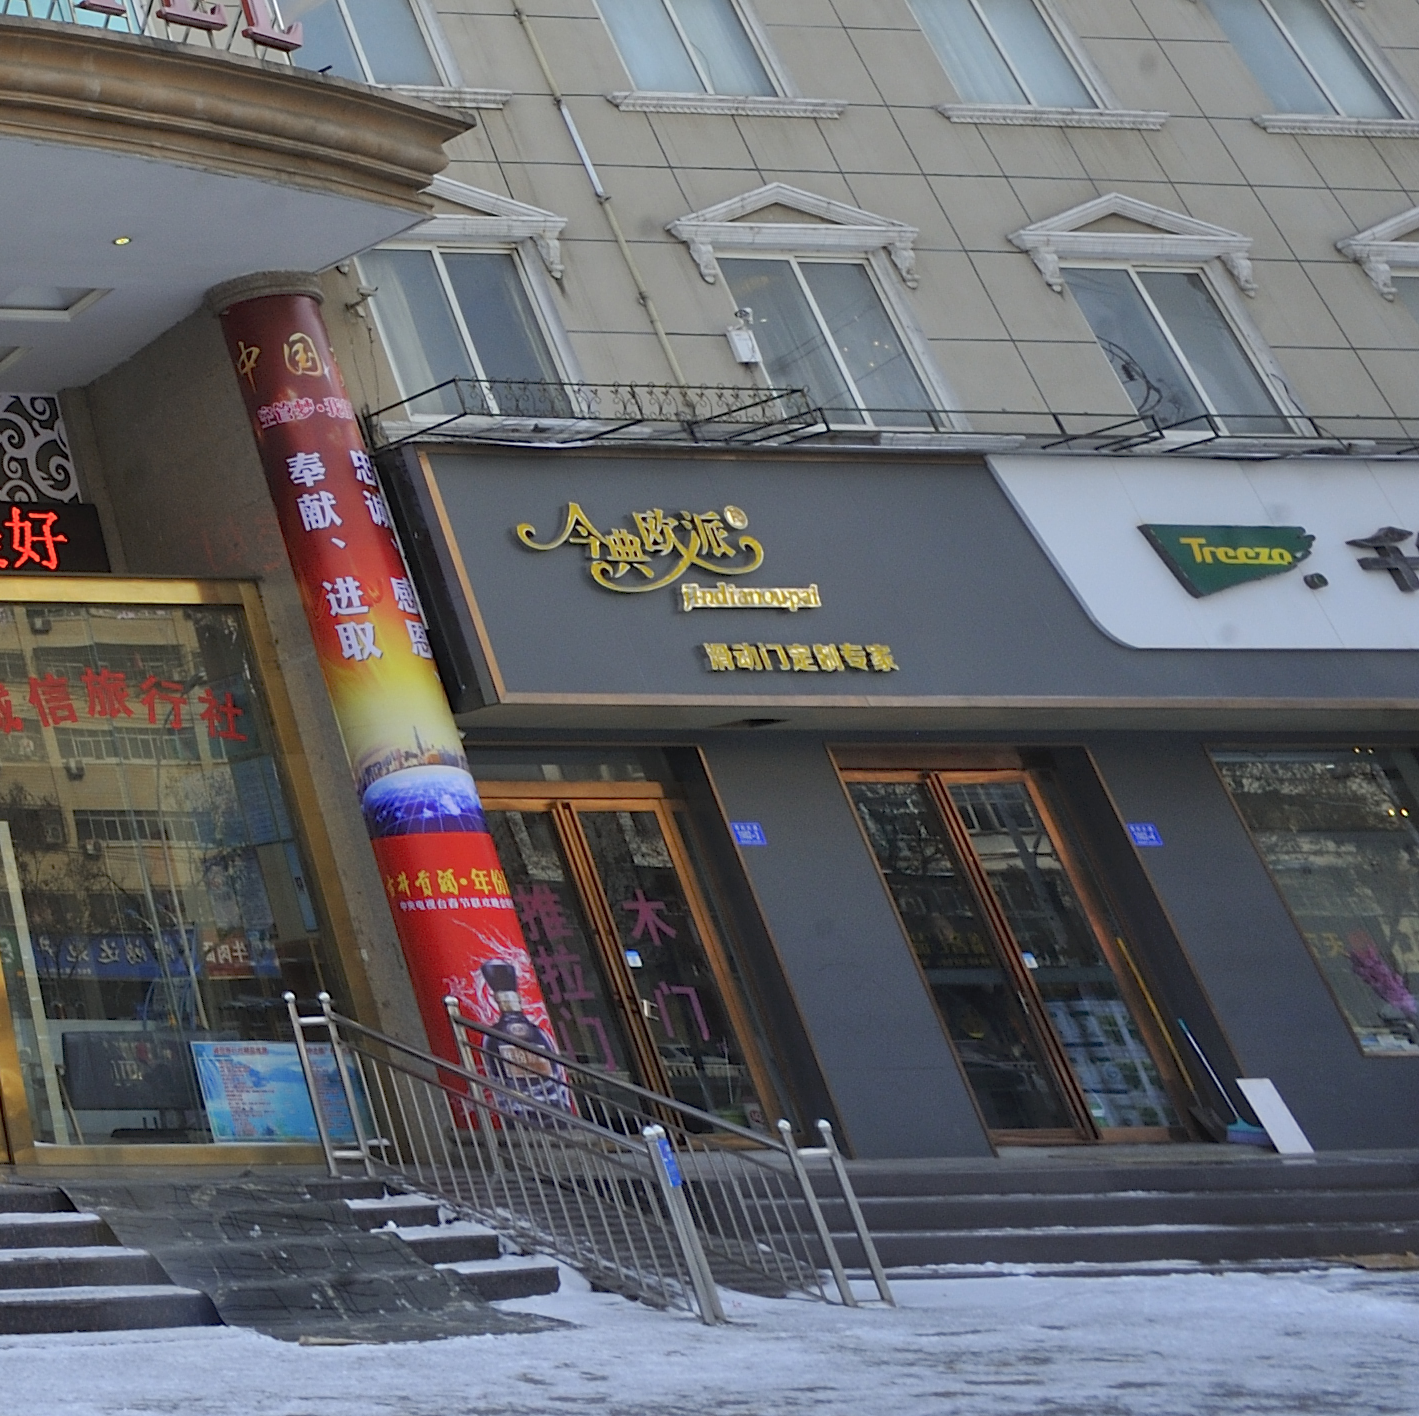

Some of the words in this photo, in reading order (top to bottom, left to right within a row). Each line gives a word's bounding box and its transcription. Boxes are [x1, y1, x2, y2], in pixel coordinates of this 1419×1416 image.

[238, 332, 344, 394] 中国
[1179, 536, 1293, 567] Treezo
[702, 641, 900, 673] 滑动门定制专家
[512, 882, 617, 1074] 推拉门
[622, 887, 712, 1042] 木门
